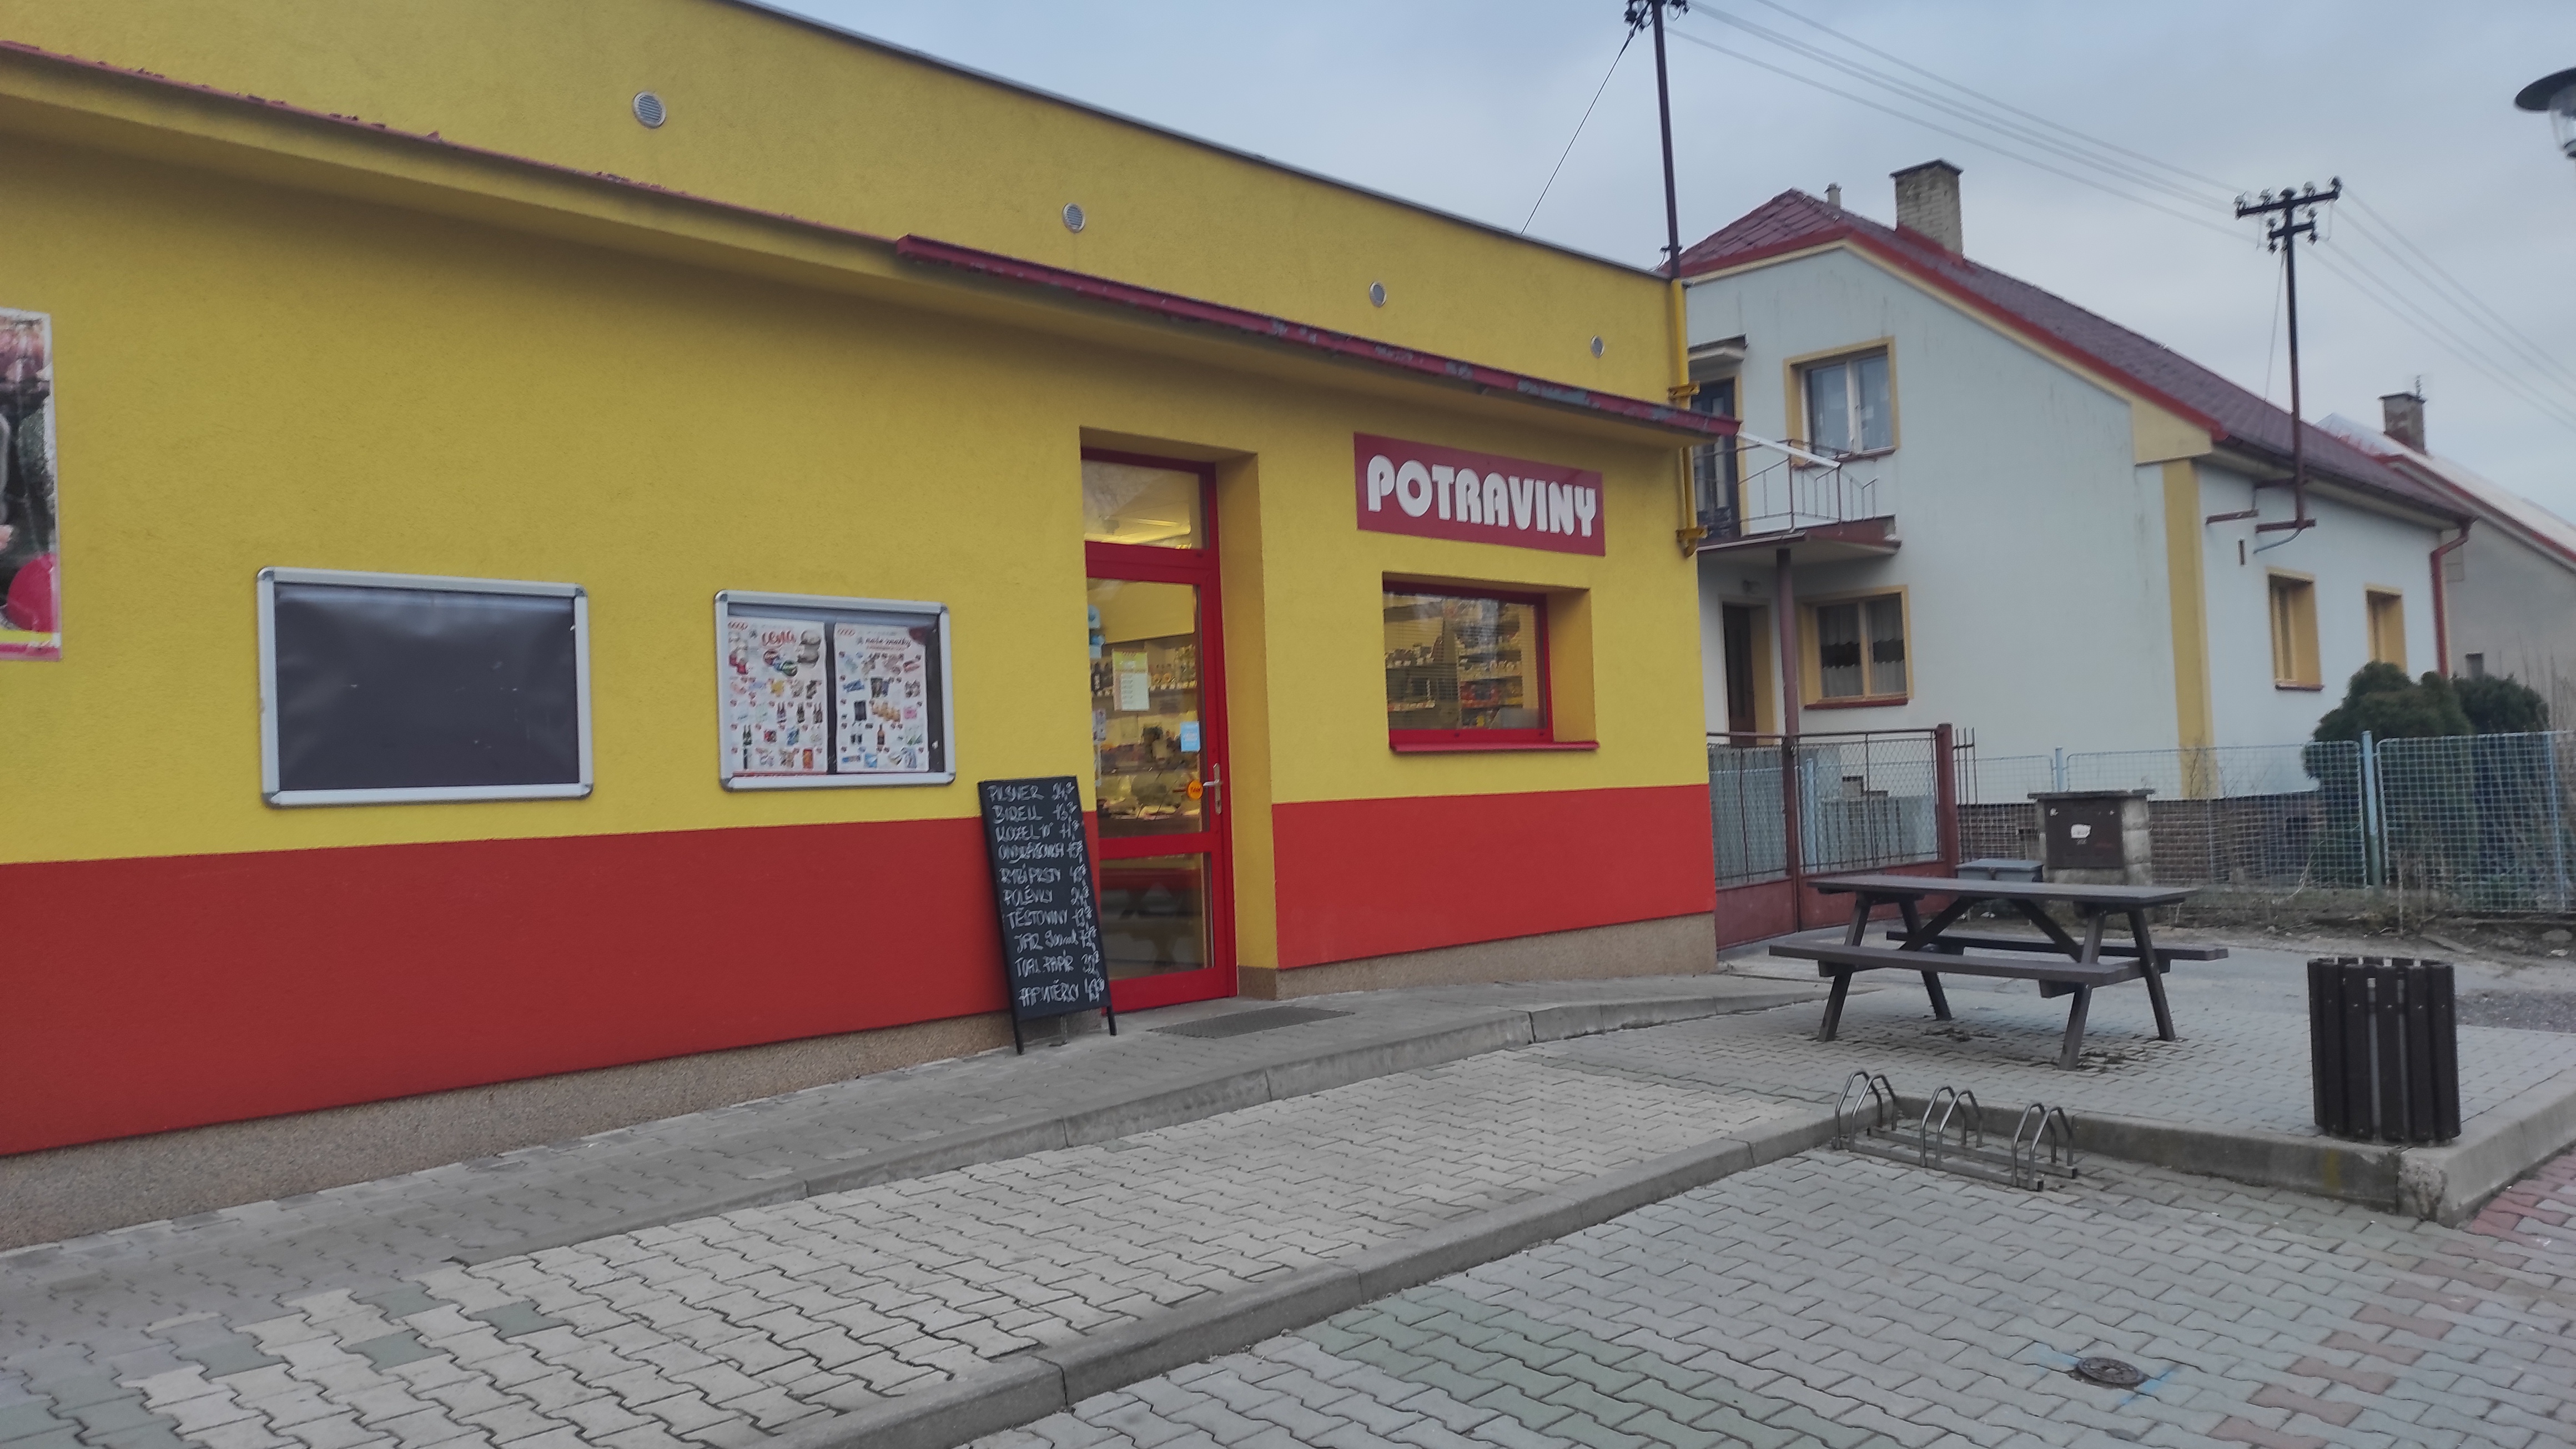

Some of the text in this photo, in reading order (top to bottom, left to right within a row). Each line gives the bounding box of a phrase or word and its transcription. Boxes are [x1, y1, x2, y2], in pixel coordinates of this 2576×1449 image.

[1367, 454, 1597, 537] POTRAVINY
[992, 805, 1043, 824] BIRELL
[995, 824, 1041, 843] KOZEL
[1014, 933, 1044, 953] JAR
